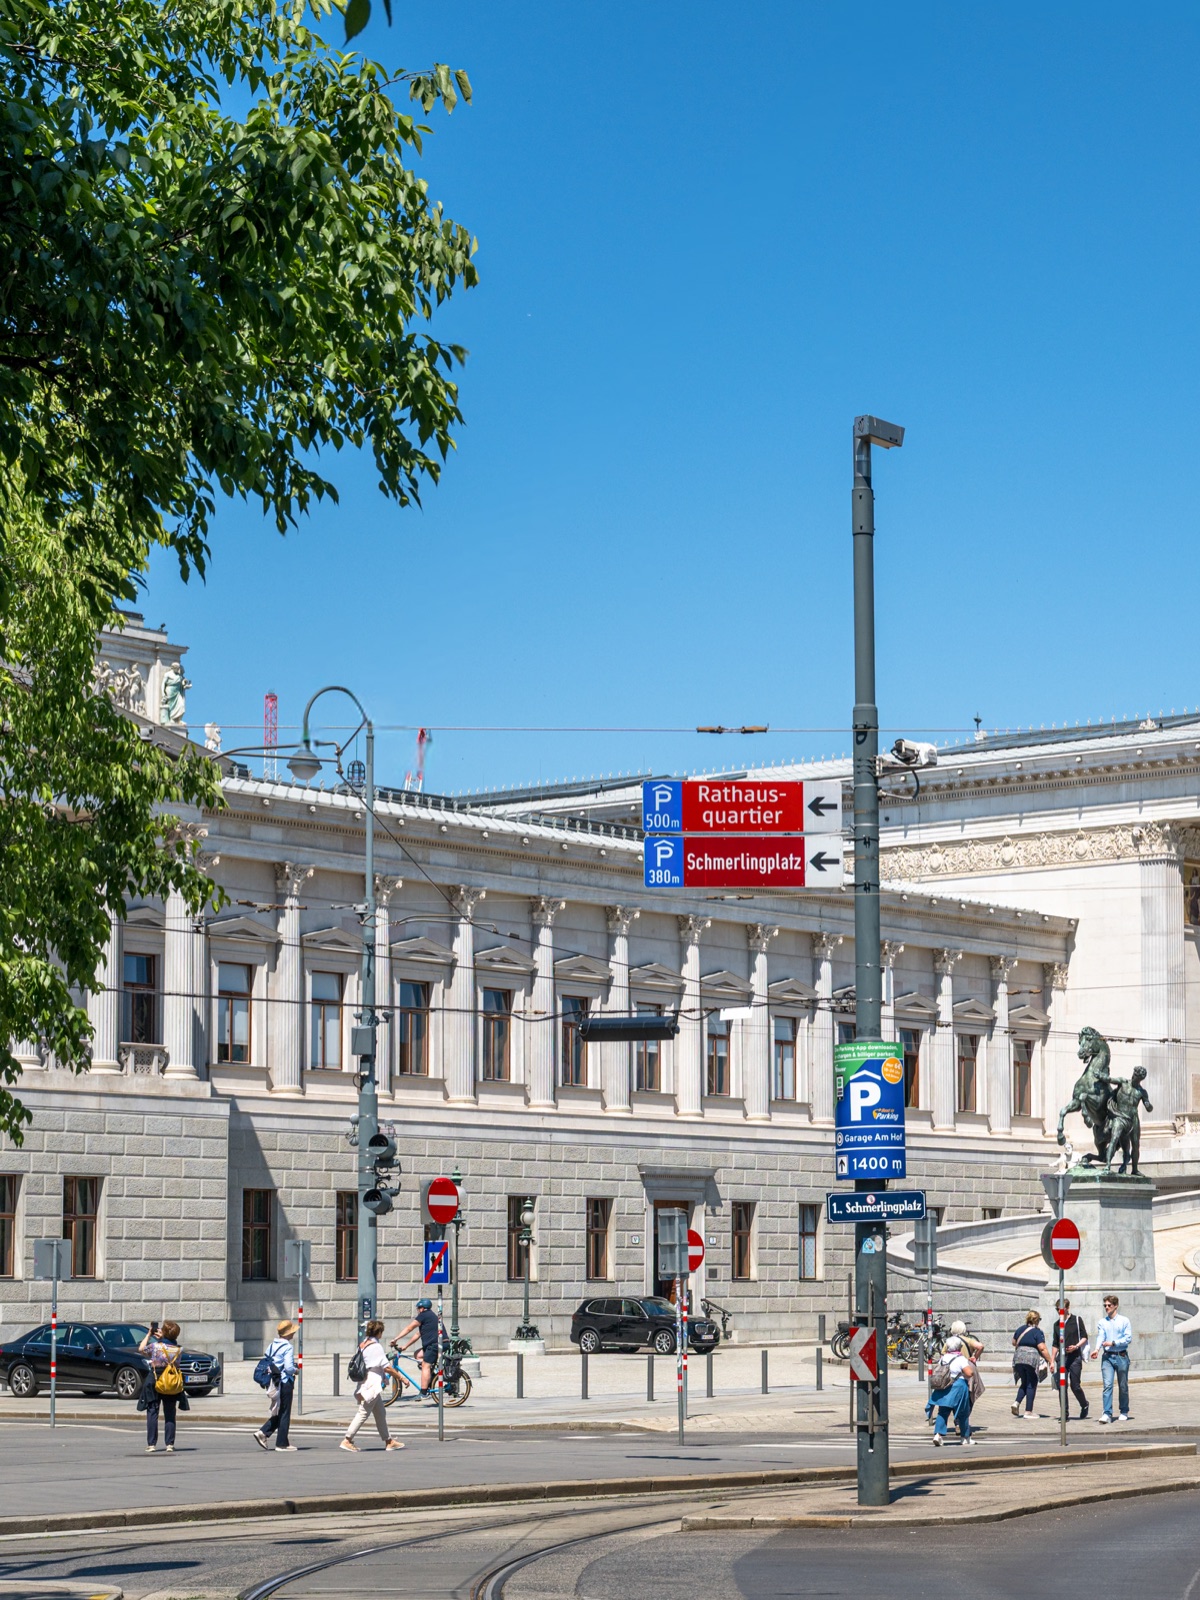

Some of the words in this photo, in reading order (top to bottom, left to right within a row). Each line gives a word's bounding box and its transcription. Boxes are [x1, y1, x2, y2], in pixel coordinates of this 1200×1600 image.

[655, 790, 672, 811] P
[698, 785, 787, 803] Rathaus-
[702, 806, 783, 828] quartier
[656, 846, 673, 867] P
[687, 853, 802, 875] Schmerlingplatz
[850, 1081, 881, 1121] P
[876, 1112, 899, 1121] Parking
[844, 1134, 873, 1143] Garage
[874, 1133, 889, 1141] Am
[890, 1133, 902, 1141] Hof
[852, 1156, 888, 1170] 1400
[892, 1159, 902, 1169] m
[845, 1200, 922, 1215] Schmerlingplatz
